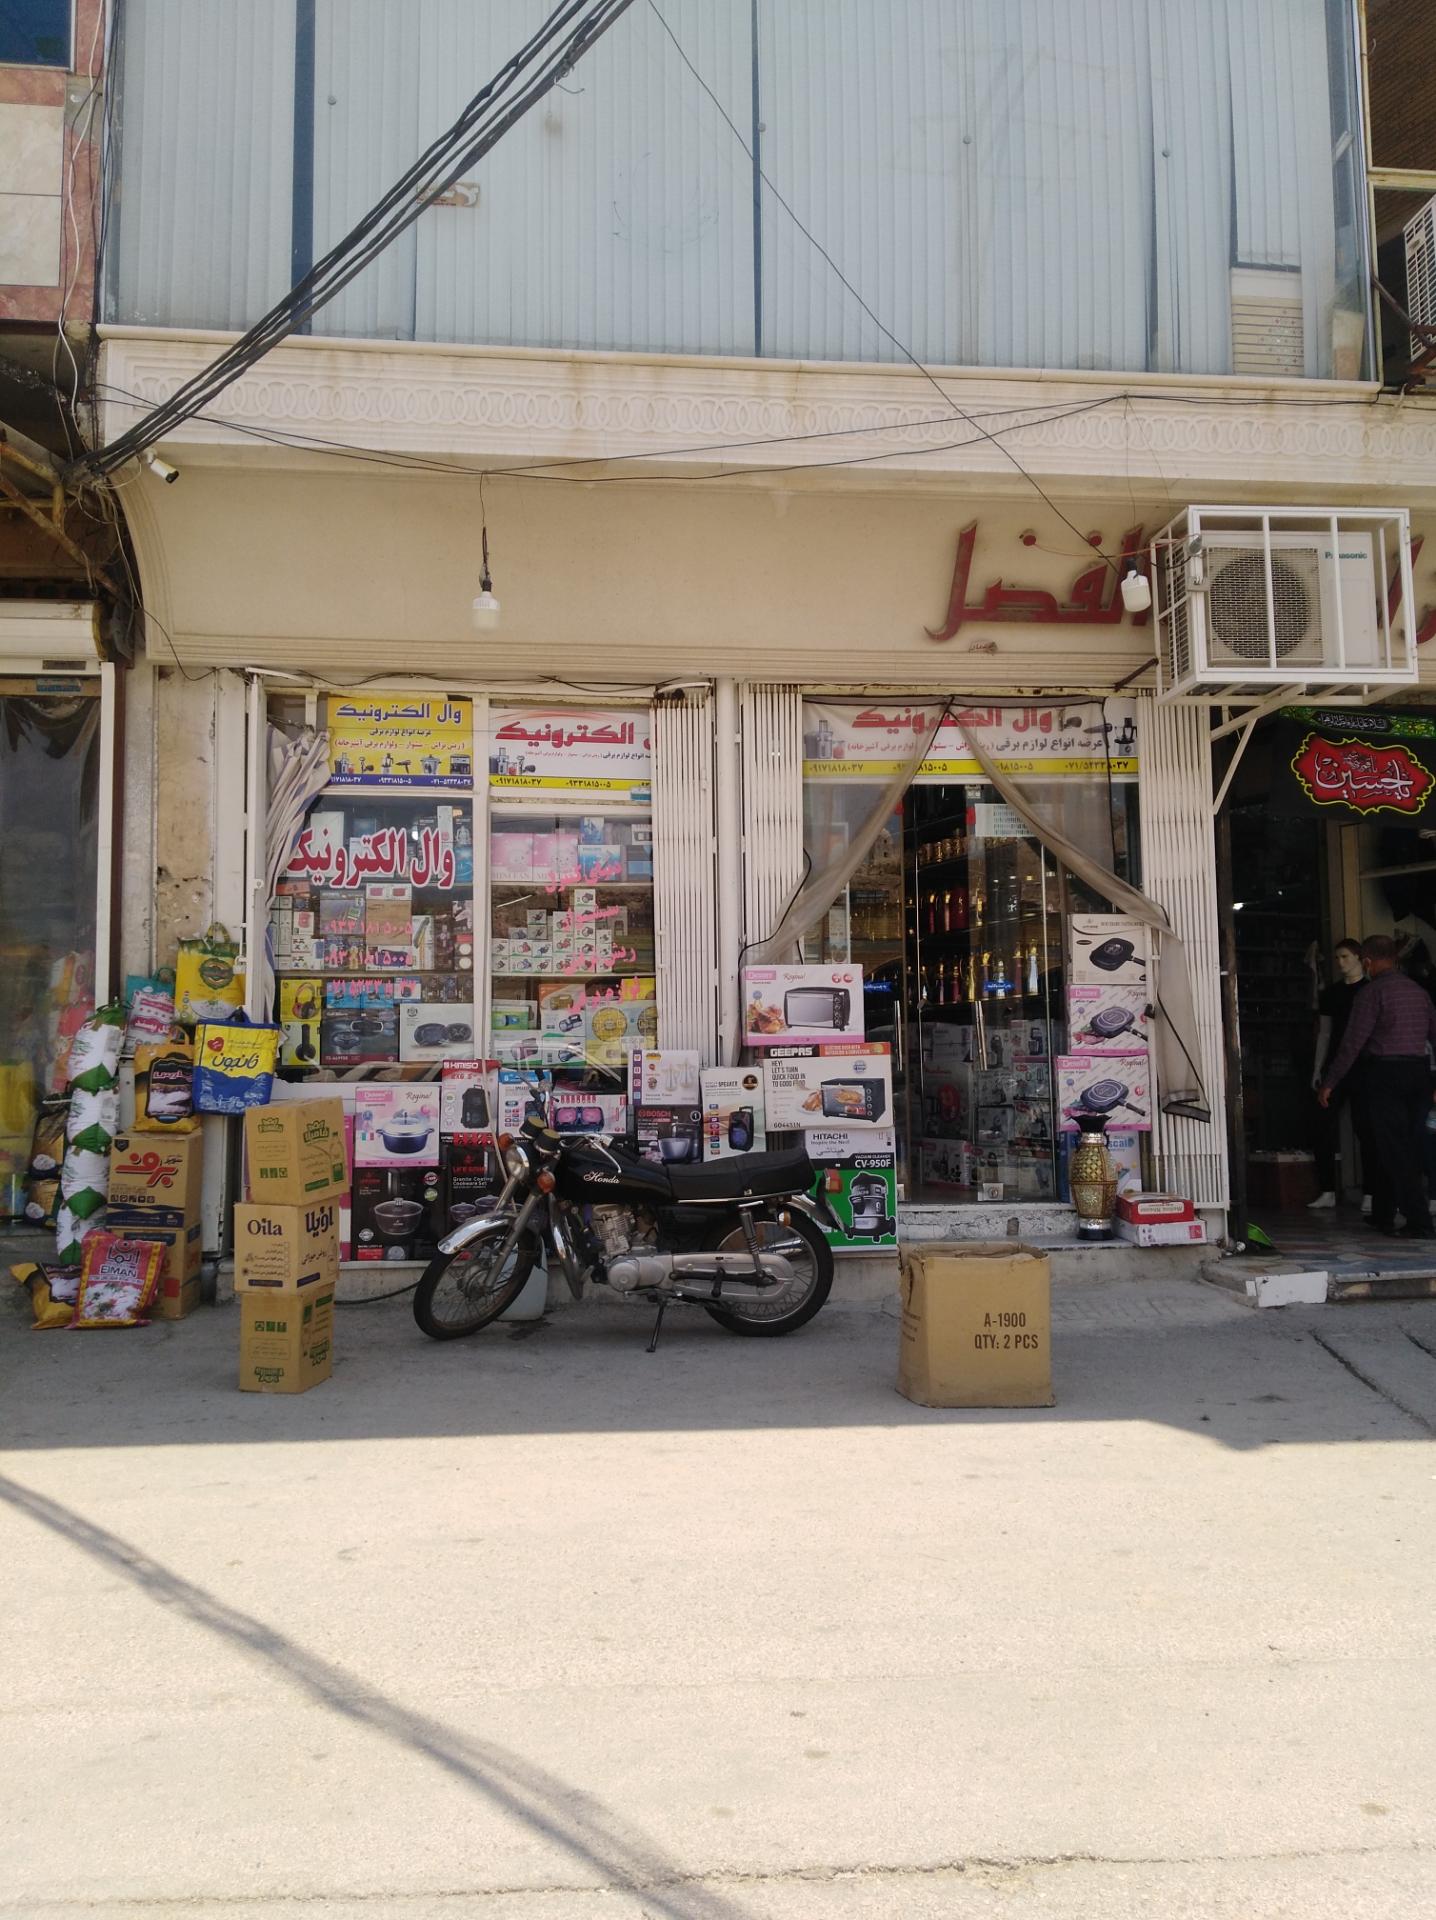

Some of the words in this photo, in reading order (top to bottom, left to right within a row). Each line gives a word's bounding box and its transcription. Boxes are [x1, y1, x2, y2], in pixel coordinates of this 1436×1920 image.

[1325, 551, 1368, 559] Paasonic
[336, 702, 430, 721] الکترونیک
[437, 703, 462, 724] وال
[1012, 706, 1053, 734] وال
[496, 721, 635, 749] الکترونیک
[995, 738, 1020, 751] برقی
[1022, 738, 1048, 750] لوازم
[1050, 738, 1075, 750] انواع
[1077, 738, 1104, 750] عرضه
[411, 828, 455, 888] وال
[769, 1046, 814, 1058] GEEPAS
[854, 1159, 892, 1168] CV-950F
[583, 1171, 620, 1184] Honda
[247, 1218, 283, 1237] Oila
[983, 1312, 1026, 1328] A-1900
[974, 1334, 1000, 1350] QTY:
[1003, 1334, 1011, 1349] 2
[1014, 1334, 1039, 1349] PCS
